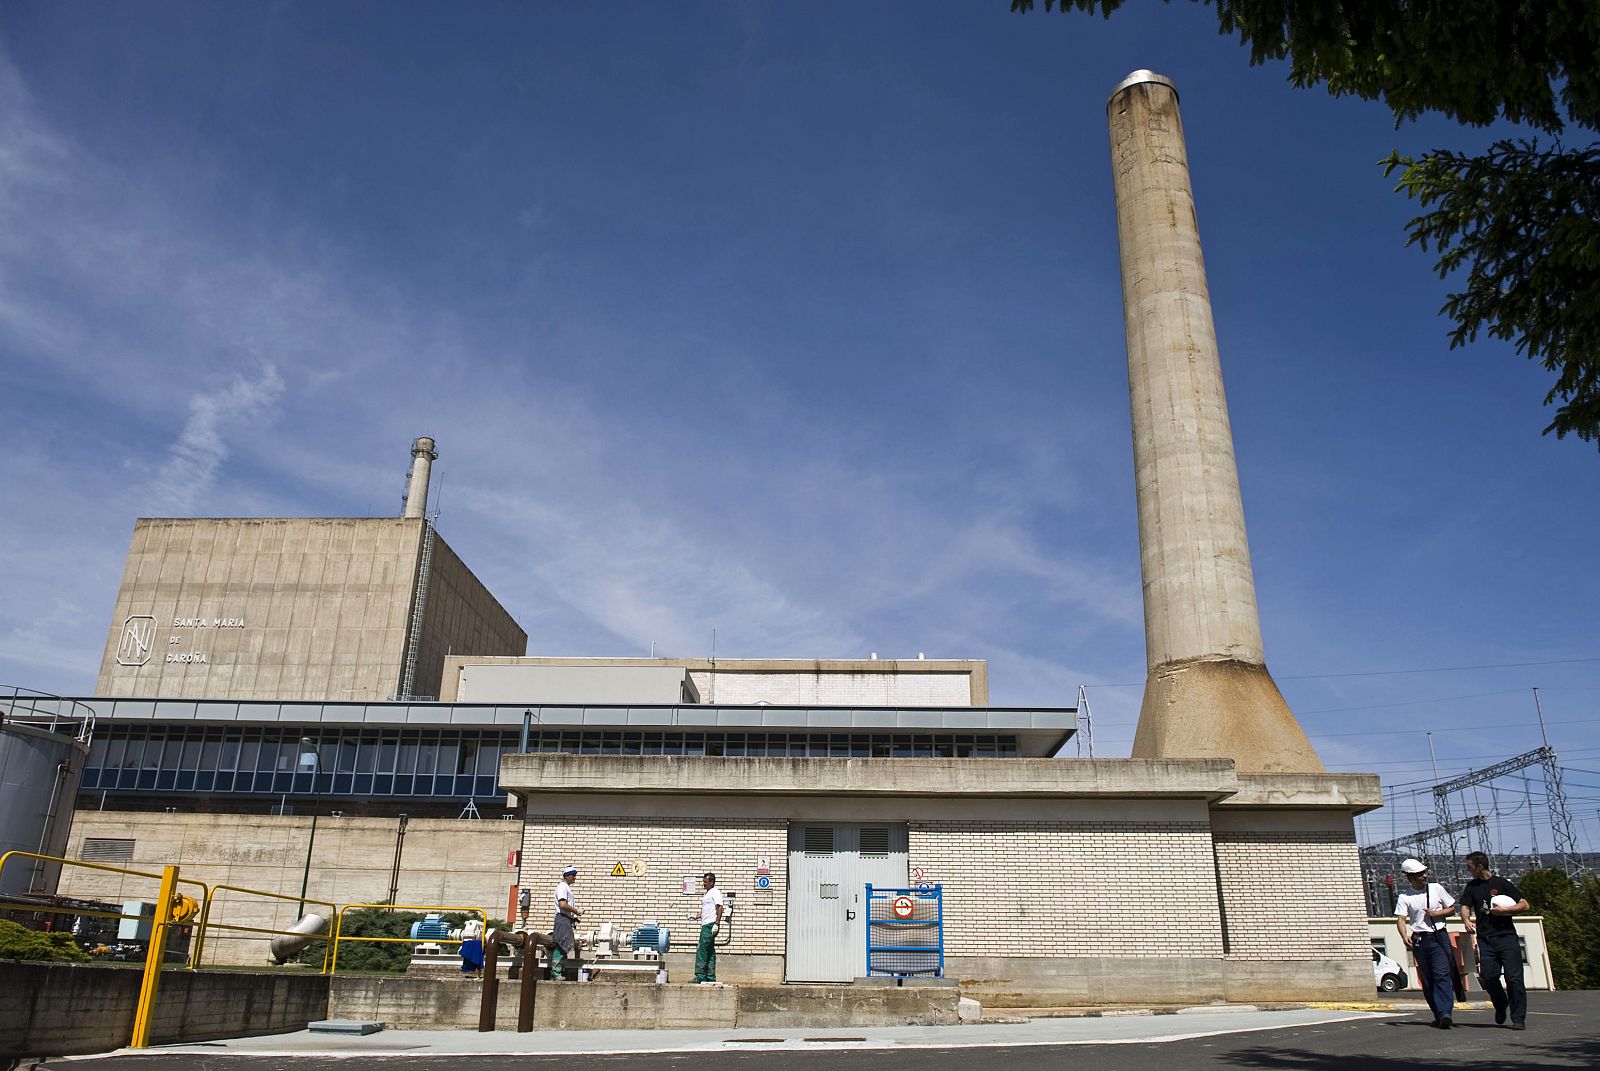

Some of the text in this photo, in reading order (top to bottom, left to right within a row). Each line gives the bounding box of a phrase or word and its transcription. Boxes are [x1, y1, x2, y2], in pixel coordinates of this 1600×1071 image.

[174, 618, 245, 628] SANTA MARIA
[170, 636, 181, 644] DE
